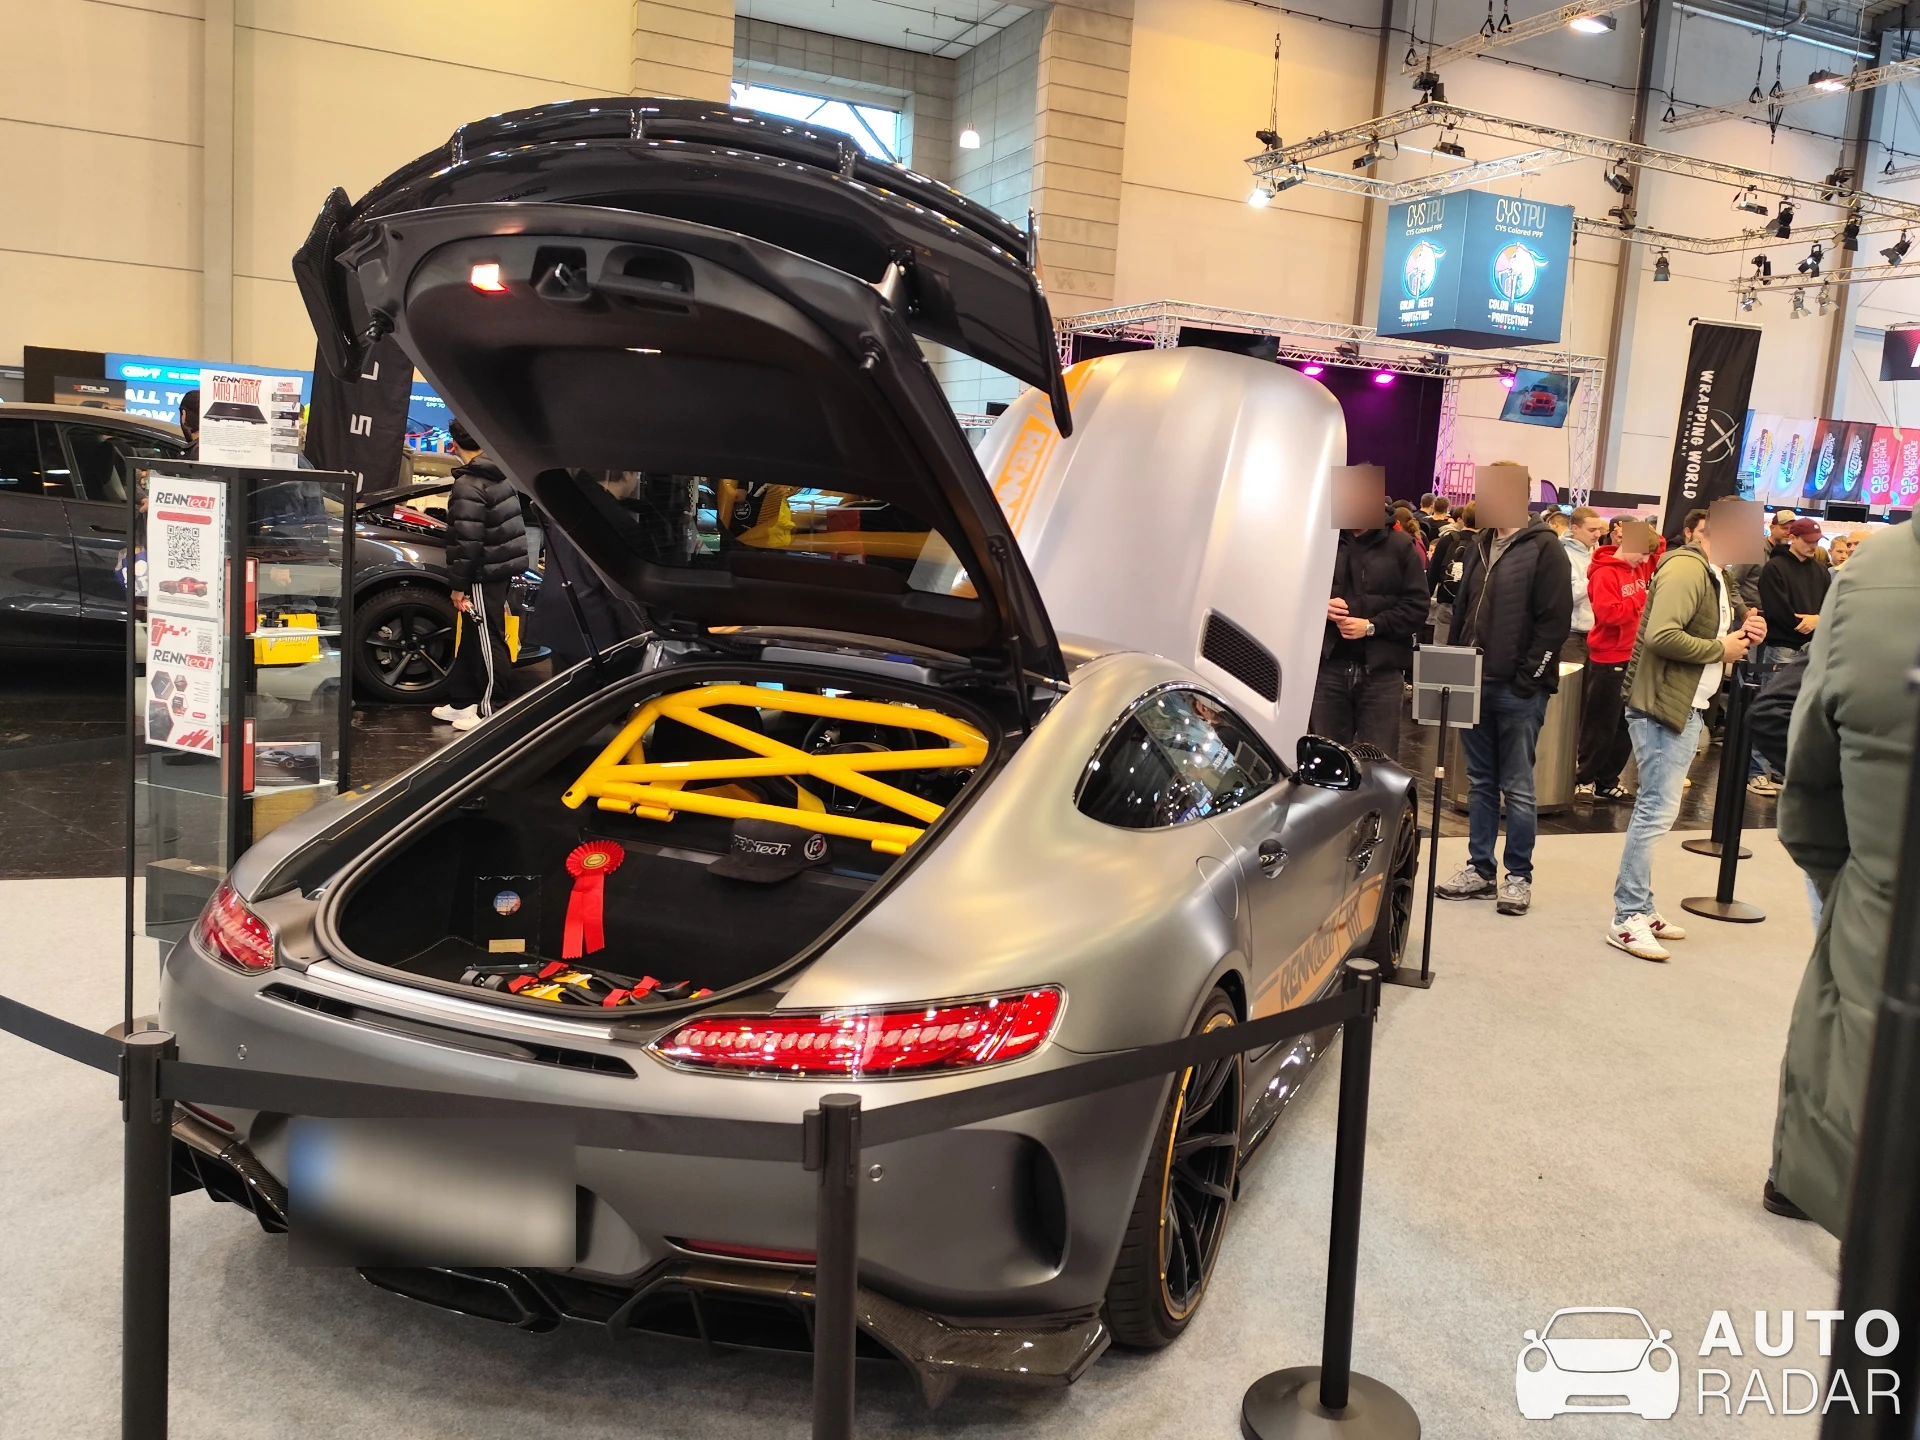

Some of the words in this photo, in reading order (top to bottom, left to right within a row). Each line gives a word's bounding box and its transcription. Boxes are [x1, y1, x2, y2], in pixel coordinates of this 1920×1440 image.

[1405, 228, 1415, 236] CYS
[1415, 225, 1433, 235] Colored
[1433, 223, 1443, 231] PPF
[1495, 224, 1507, 232] CYS
[1507, 226, 1531, 236] Colored
[1531, 230, 1543, 238] PPF
[1488, 299, 1509, 312] COLOR
[1513, 302, 1535, 315] MEETS
[233, 384, 260, 404] AIRBOX
[1690, 370, 1715, 446] WRAPPING
[1681, 410, 1694, 457] GERMANY
[1682, 450, 1703, 499] WORLD
[155, 491, 216, 510] RENNtech
[152, 649, 215, 671] RENNtech
